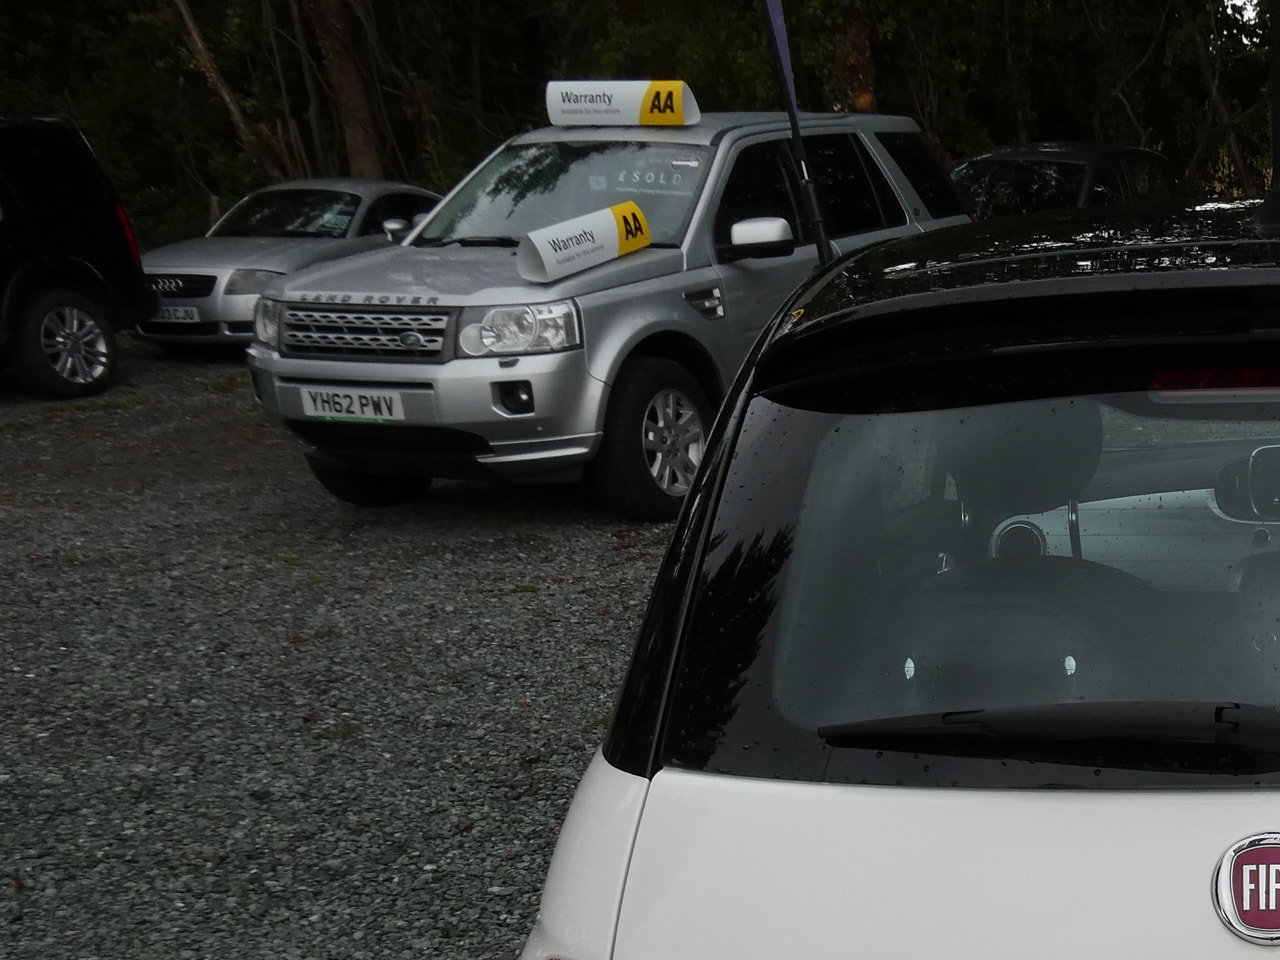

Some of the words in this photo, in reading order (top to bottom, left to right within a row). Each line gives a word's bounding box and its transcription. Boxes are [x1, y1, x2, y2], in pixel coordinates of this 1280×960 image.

[560, 91, 613, 106] Warranty
[649, 91, 675, 114] AA
[622, 212, 644, 240] AA
[548, 229, 595, 253] Warranty
[300, 293, 351, 303] LAND
[363, 295, 439, 304] ROVER
[308, 390, 355, 414] YH62
[358, 394, 394, 416] PWV
